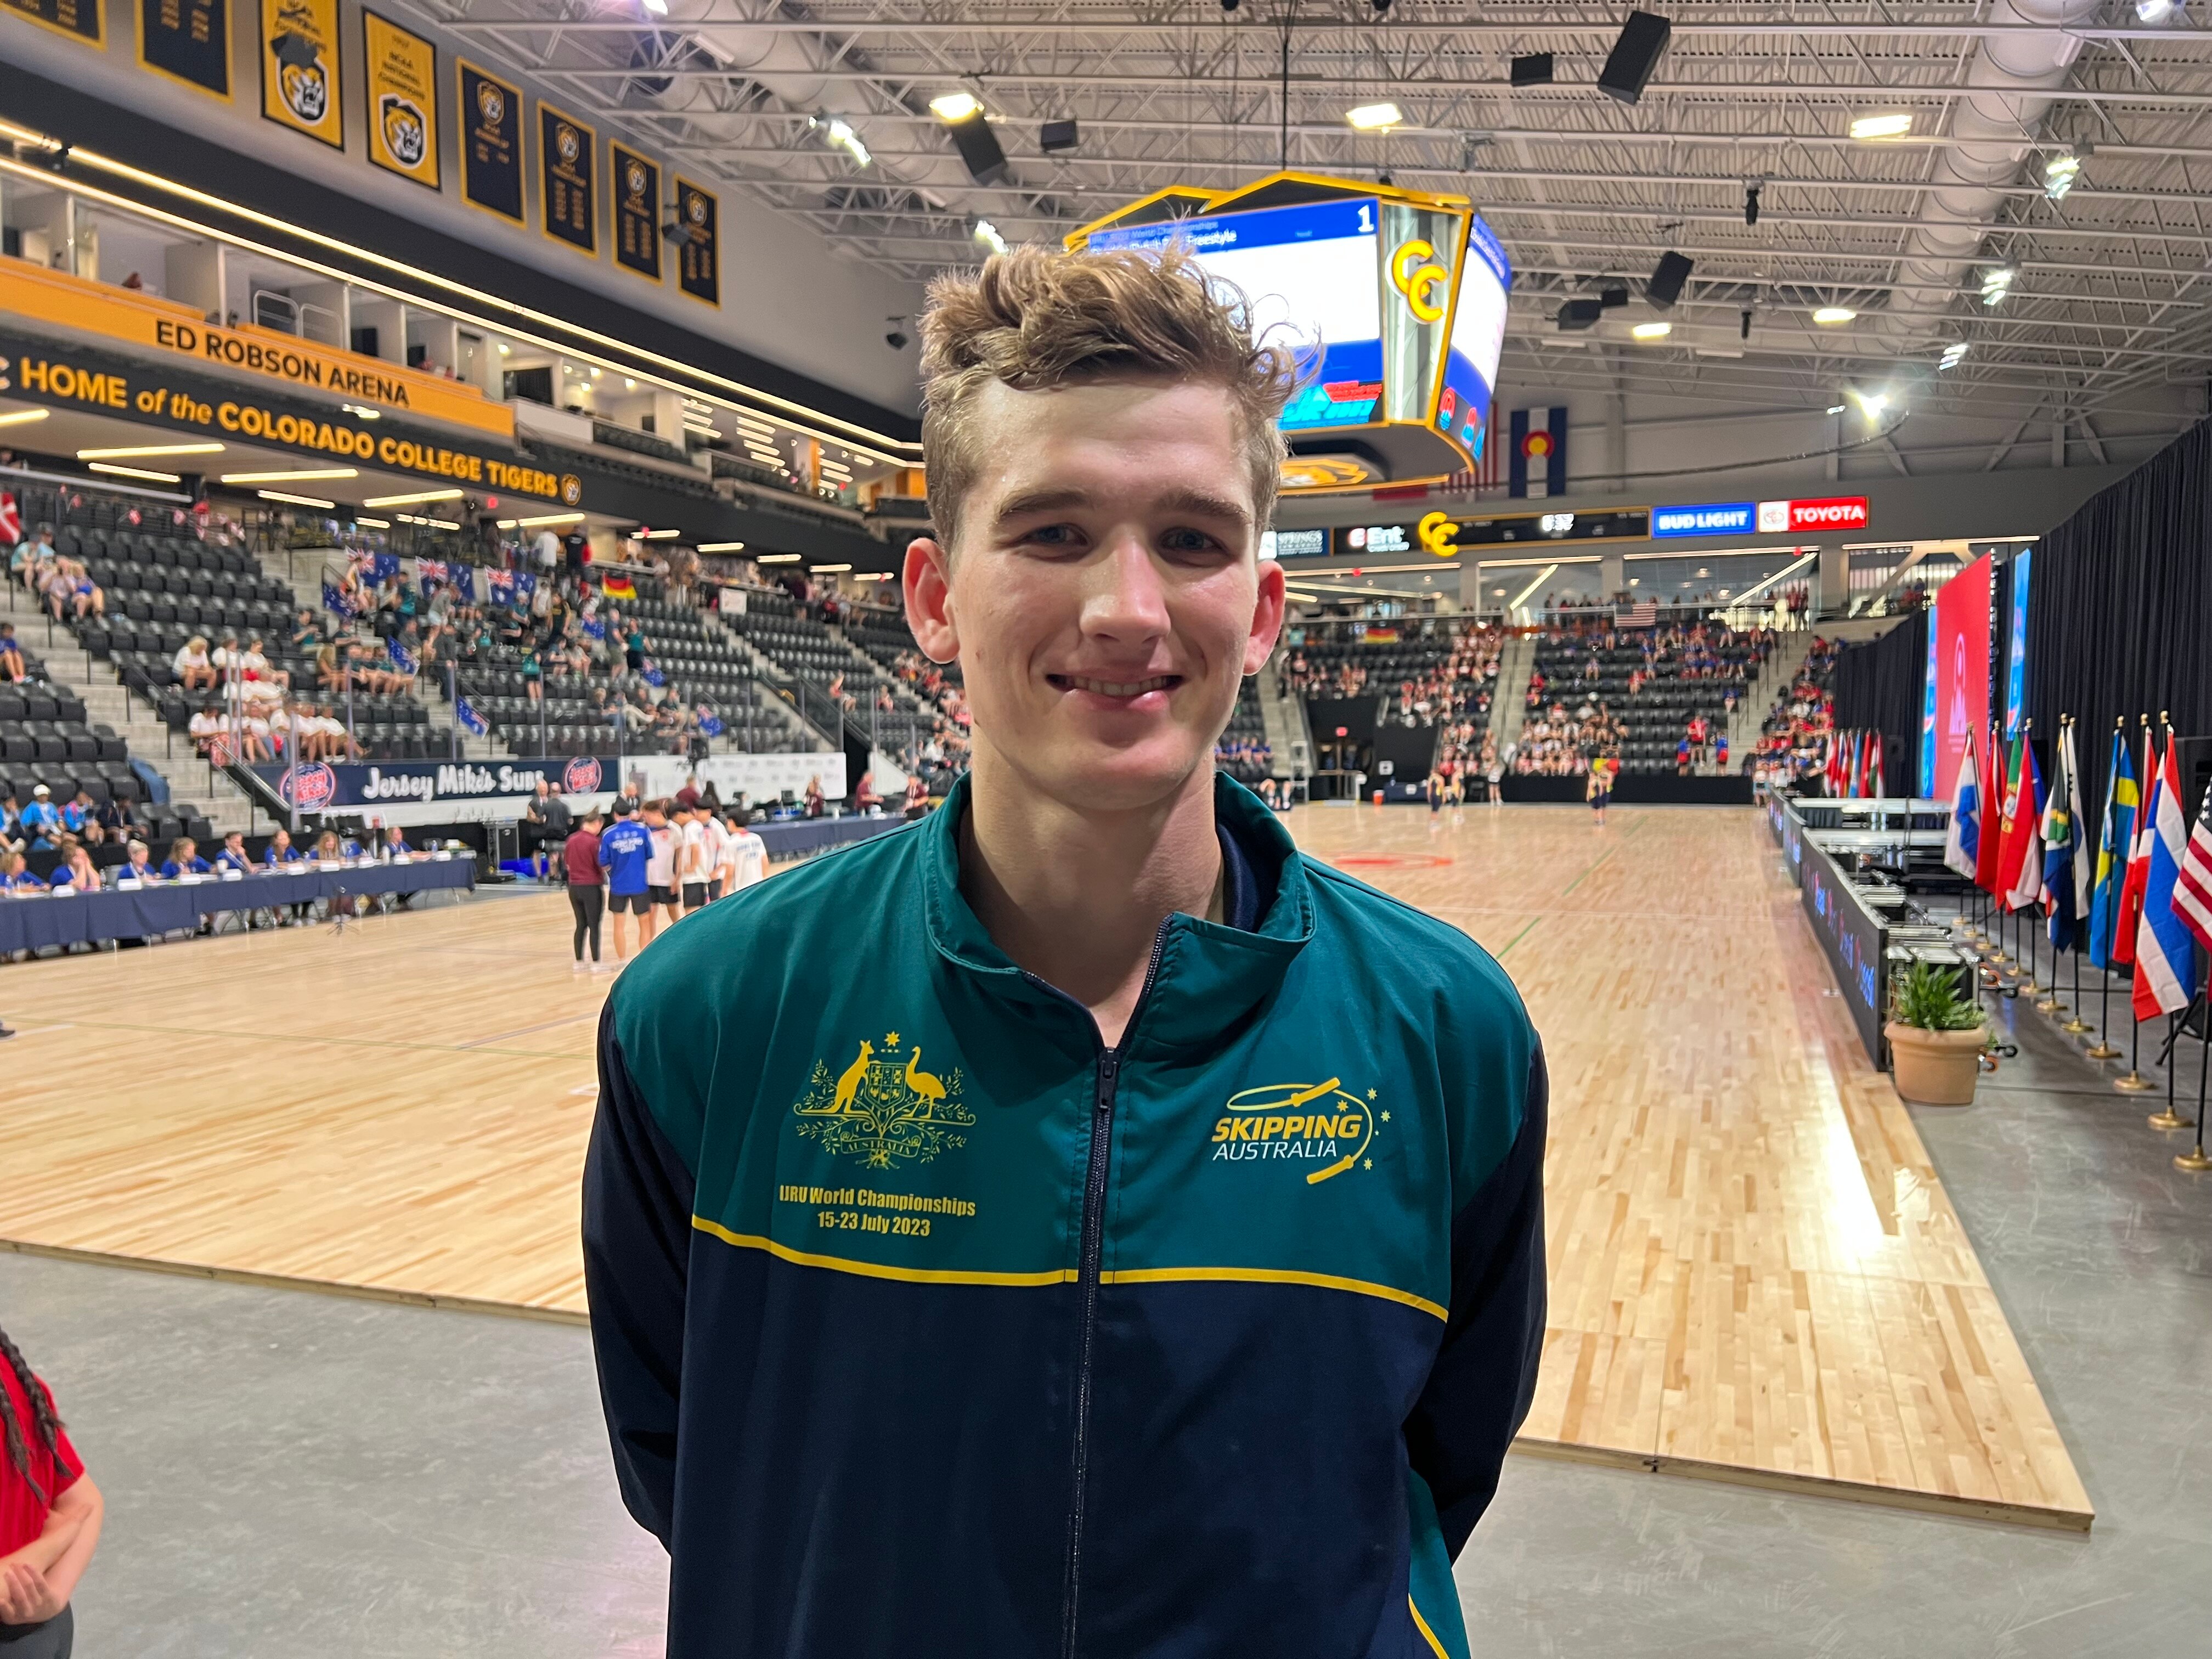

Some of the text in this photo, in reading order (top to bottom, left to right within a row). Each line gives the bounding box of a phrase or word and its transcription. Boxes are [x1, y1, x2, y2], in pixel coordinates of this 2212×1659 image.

[1358, 204, 1374, 232] 1
[156, 320, 410, 408] ED ROBSON ARENA
[20, 357, 128, 409] HOME
[136, 388, 167, 415] of
[171, 393, 213, 425] the
[217, 401, 375, 459] COLORADO
[379, 437, 482, 482] COLLEGE
[485, 459, 558, 498] TIGERS
[1658, 513, 1696, 531] BUD
[1696, 511, 1747, 528] LIGHT
[1793, 505, 1865, 523] TOYOTA
[363, 766, 433, 804] Jersey
[438, 764, 496, 794] Mike's
[1211, 1115, 1363, 1142] SKIPPING
[847, 1139, 911, 1155] AUSTRALIA
[1212, 1140, 1338, 1161] AUSTRALIA
[779, 1184, 977, 1217] IJRU World Championships
[817, 1211, 931, 1237] 15-23 July 2023
